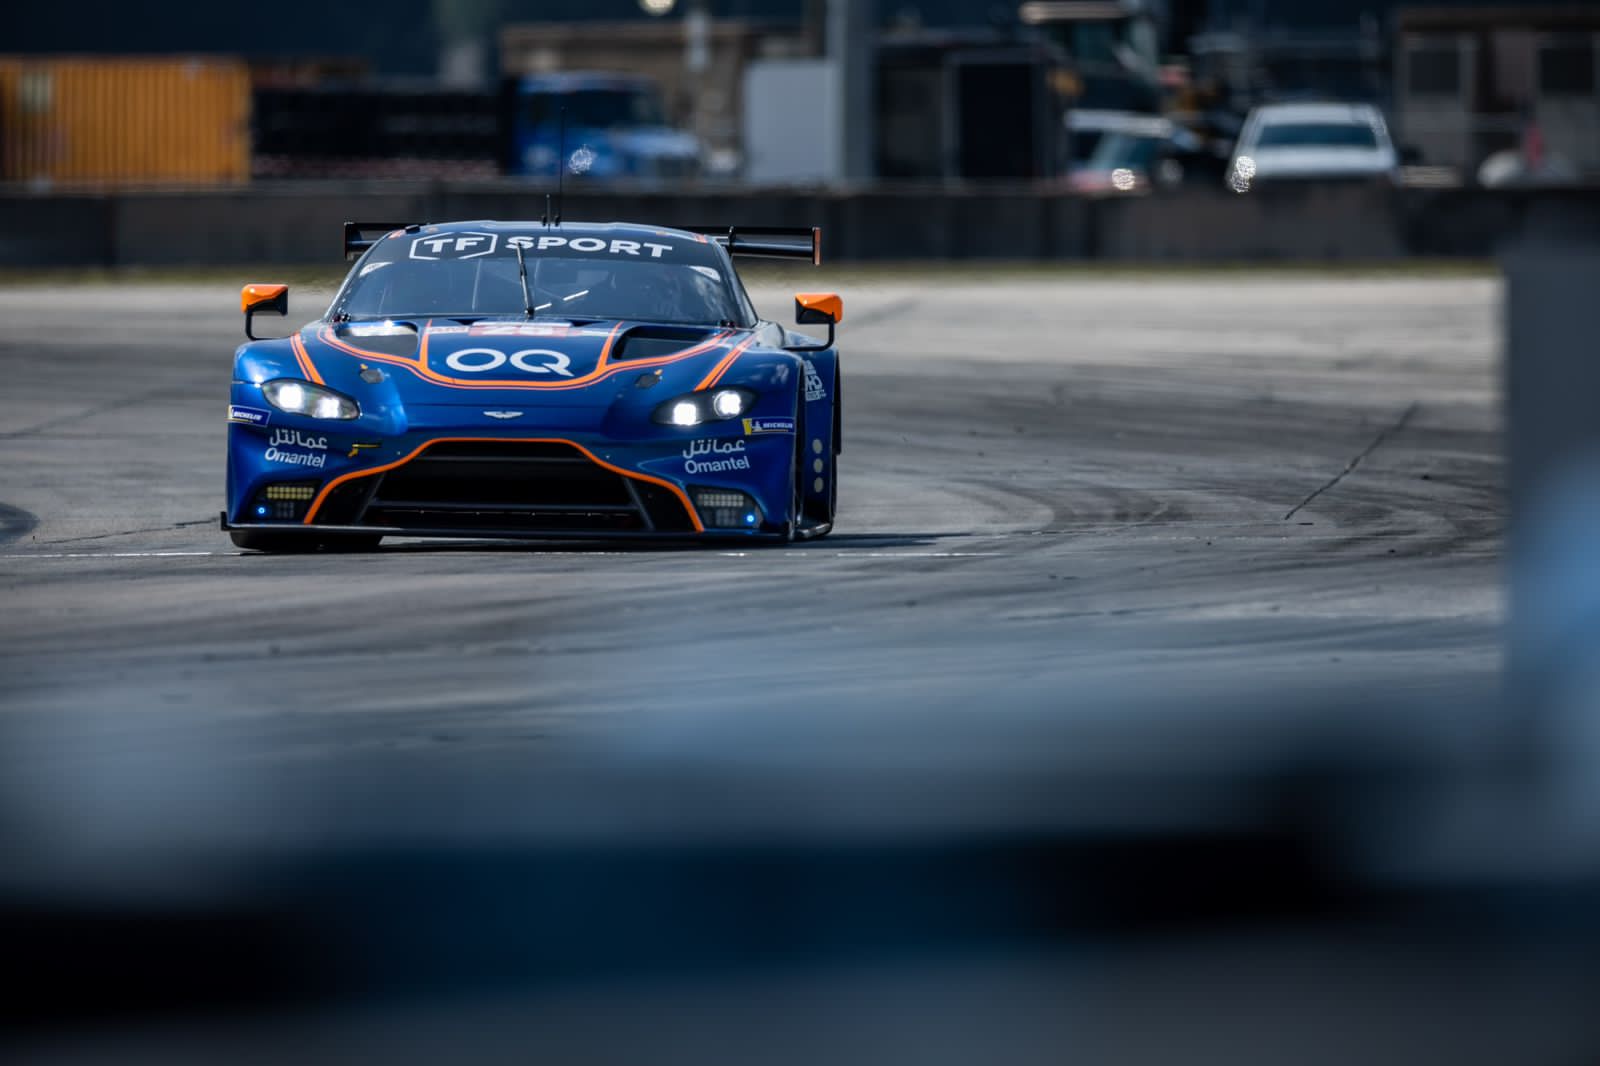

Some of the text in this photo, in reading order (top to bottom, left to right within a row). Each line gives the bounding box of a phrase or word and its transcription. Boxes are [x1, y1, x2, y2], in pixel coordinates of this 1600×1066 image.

[423, 236, 673, 258] TF SPORT
[446, 348, 574, 377] OQ
[269, 428, 328, 449] عمانتل
[682, 439, 745, 459] عمانتل
[264, 447, 326, 468] Omantel
[684, 456, 750, 474] Omantel
